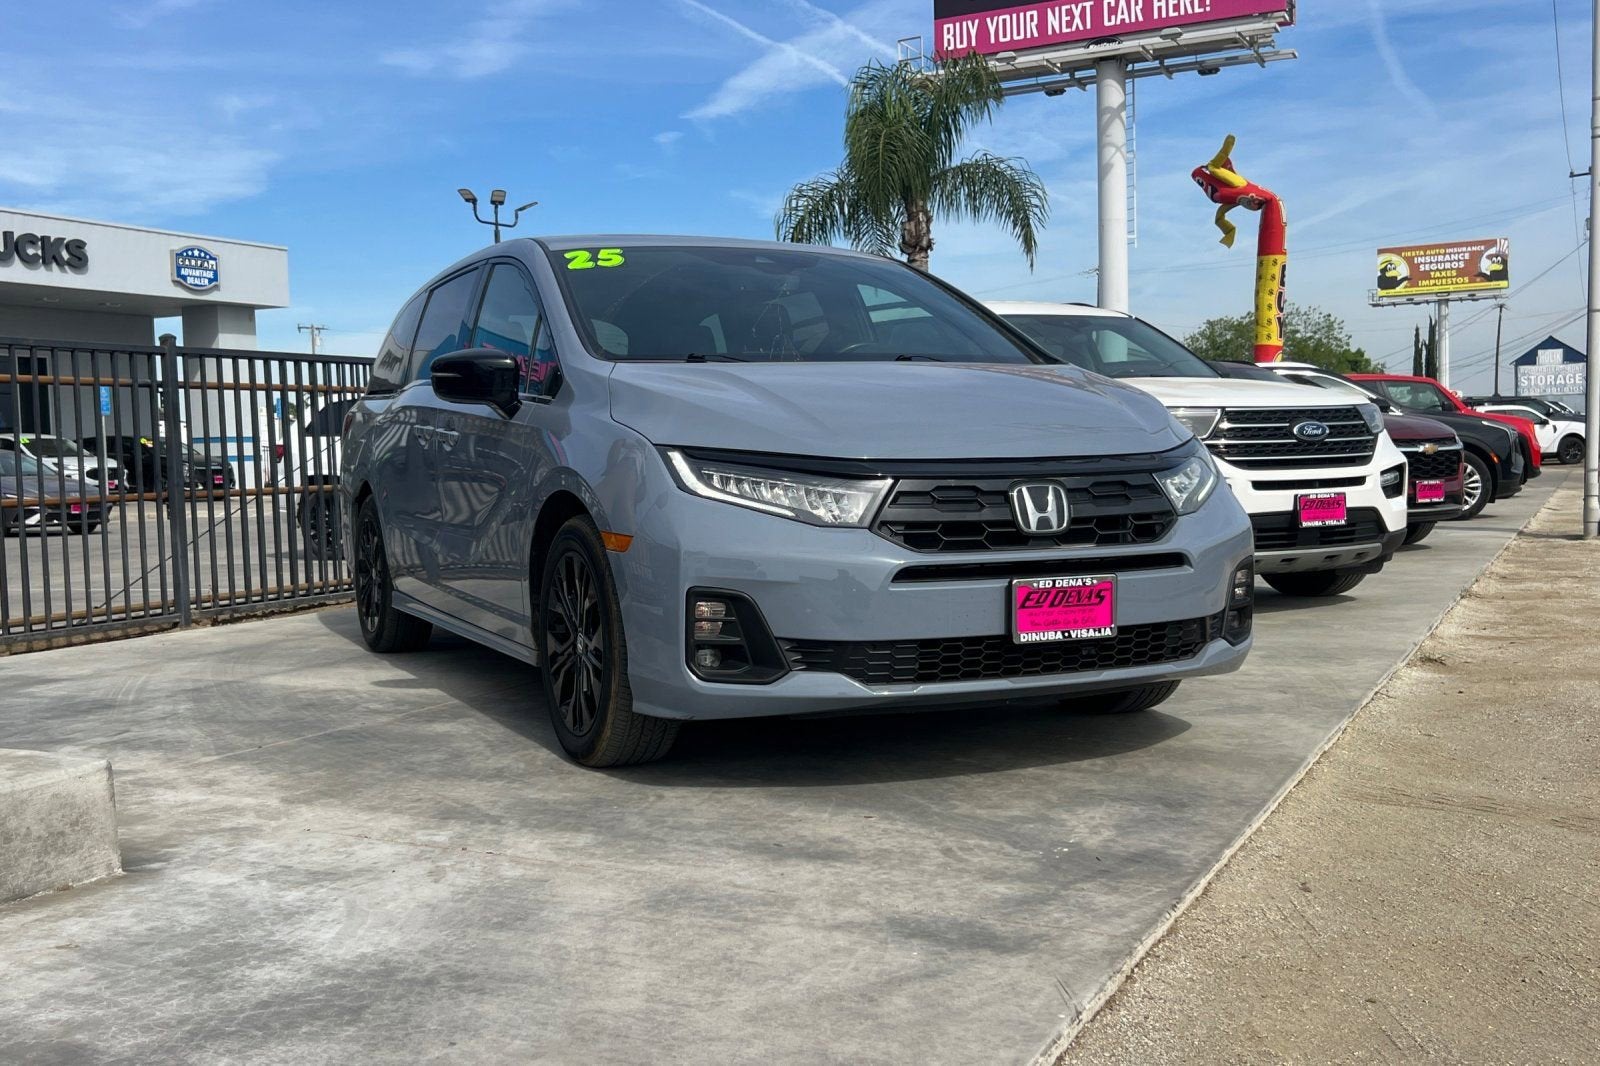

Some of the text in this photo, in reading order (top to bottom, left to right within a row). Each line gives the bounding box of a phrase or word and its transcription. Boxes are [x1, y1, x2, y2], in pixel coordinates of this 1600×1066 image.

[943, 19, 979, 51] BUY
[986, 10, 1039, 44] YOUR
[1047, 1, 1094, 36] NEXT
[1103, 0, 1143, 27] CAR
[1446, 245, 1485, 254] INSURANCE
[178, 257, 216, 270] CARFAX
[563, 248, 625, 270] 25
[1414, 252, 1470, 264] INSURANCE
[1419, 261, 1465, 271] SEGUROS
[180, 267, 215, 279] ADVANTAGE
[1430, 270, 1457, 278] TAXES
[186, 276, 209, 286] DEALER
[1418, 277, 1469, 287] IMPUESTOS
[1520, 373, 1583, 387] STORAGE
[1303, 425, 1322, 435] Ford
[1038, 578, 1093, 588] ED DENA'S
[1018, 589, 1051, 610] ED
[1020, 627, 1112, 642] DINUBA VISALIA
